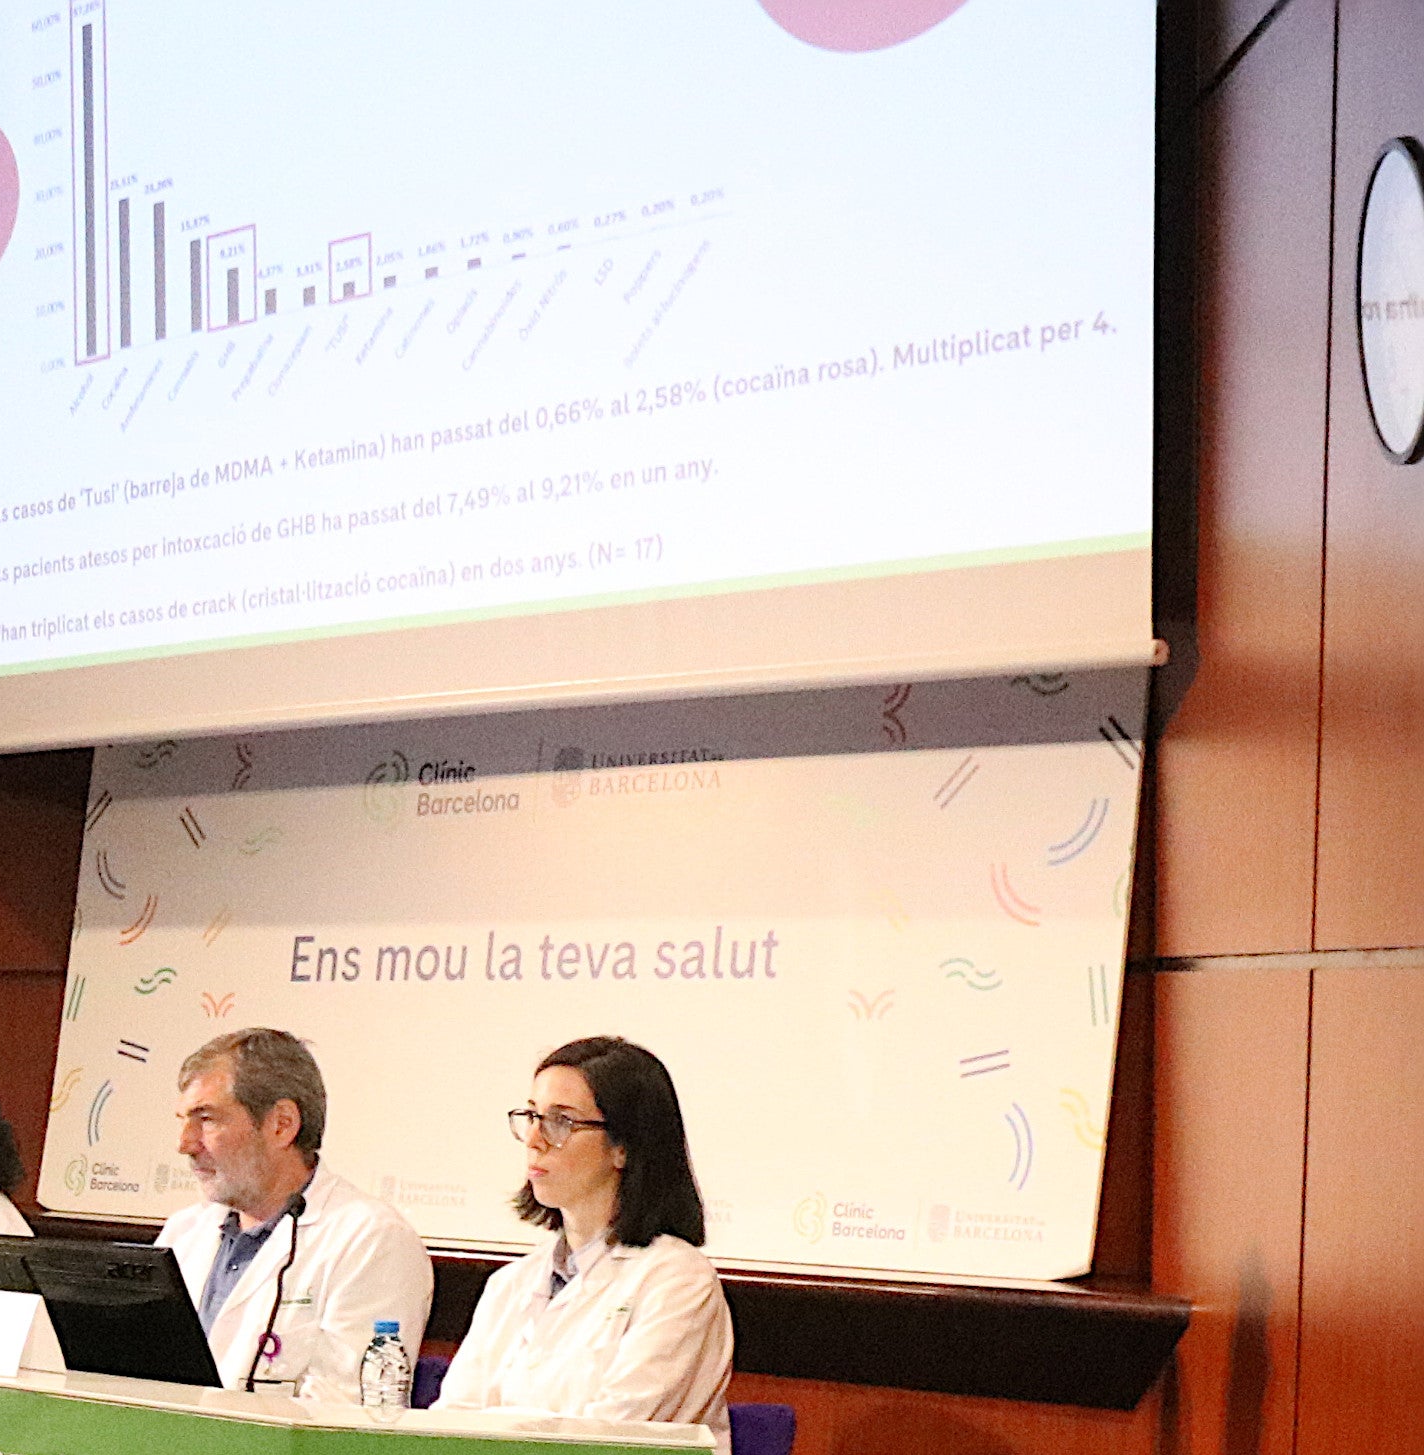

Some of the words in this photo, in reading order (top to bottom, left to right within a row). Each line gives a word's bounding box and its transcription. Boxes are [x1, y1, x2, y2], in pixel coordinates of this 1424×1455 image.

[594, 258, 614, 287] LSD
[13, 499, 53, 522] casos
[57, 494, 76, 513] de
[123, 472, 186, 504] (barreja
[190, 468, 209, 488] de
[215, 456, 273, 484] MDMA
[294, 434, 386, 470] Ketamina)
[391, 432, 424, 455] han
[430, 418, 493, 452] passat
[498, 410, 529, 436] del
[535, 397, 604, 430] 0,66%
[610, 393, 629, 418] al
[636, 381, 707, 414] 2,58%
[713, 365, 810, 402] (cocaïna
[818, 348, 884, 378] rosa).
[893, 325, 1031, 371] Multiplicat
[1040, 318, 1083, 352] per
[1093, 310, 1118, 336] 4.
[13, 555, 75, 584] pacients
[79, 548, 128, 571] atesos
[132, 543, 158, 567] per
[251, 521, 272, 542] de
[277, 513, 316, 538] GHB
[321, 512, 342, 532] ha
[348, 501, 406, 535] passat
[413, 492, 441, 518] del
[447, 483, 510, 516] 7,49%
[516, 480, 535, 503] al
[541, 469, 604, 502] 9,21%
[610, 469, 635, 491] en
[641, 465, 667, 484] un
[674, 456, 719, 484] any.
[31, 612, 90, 641] triplicat
[94, 606, 115, 630] els
[119, 601, 163, 625] casos
[168, 601, 188, 619] de
[192, 593, 236, 617] crack
[376, 560, 455, 593] cocaïna)
[461, 559, 483, 582] en
[490, 554, 524, 577] dos
[531, 553, 582, 577] anys.
[588, 541, 626, 570] (N=
[635, 533, 663, 562] 17)
[418, 760, 476, 785] Clínic
[590, 770, 721, 796] BARCELONA
[416, 788, 520, 816] Barcelona
[289, 935, 360, 983] Ens
[375, 943, 468, 982] mou
[485, 930, 523, 981] la
[539, 934, 637, 980] teva
[654, 926, 779, 980] salut
[92, 1162, 120, 1176] Clínic
[90, 1177, 140, 1193] Barcelona
[833, 1202, 874, 1220] Clínic
[831, 1222, 906, 1242] Barcelona
